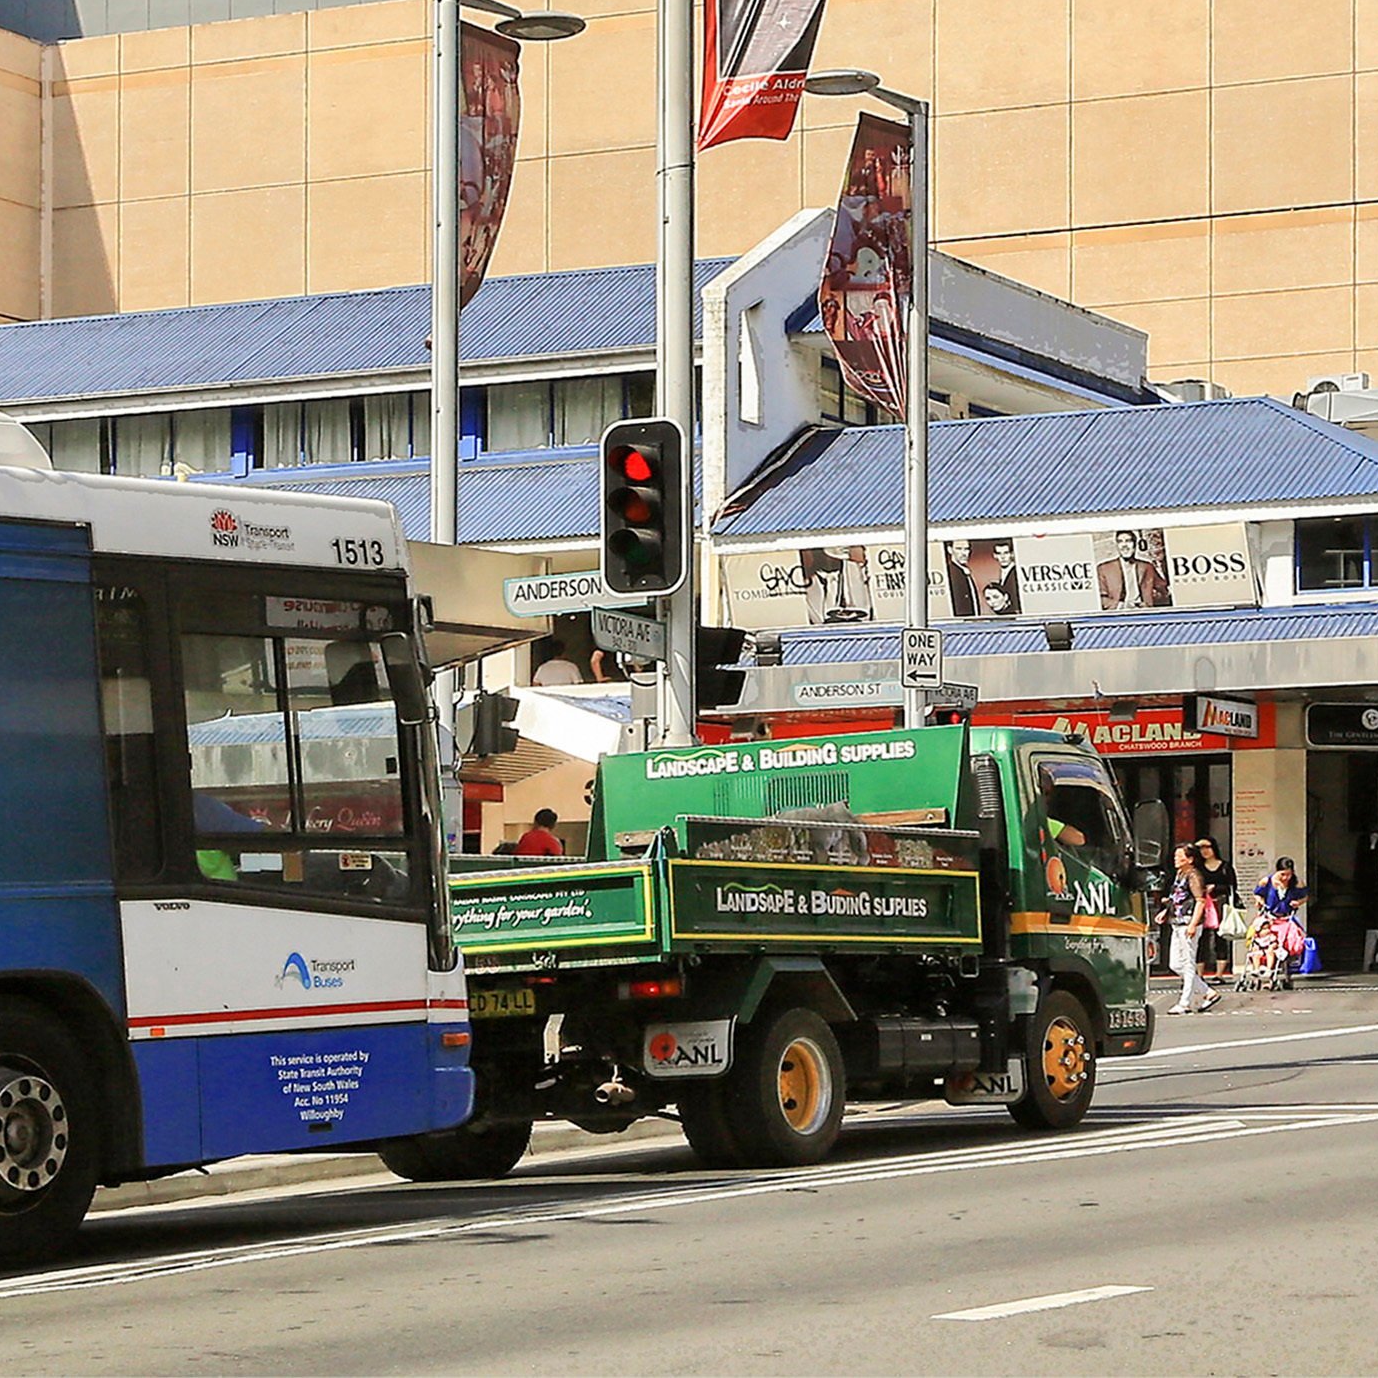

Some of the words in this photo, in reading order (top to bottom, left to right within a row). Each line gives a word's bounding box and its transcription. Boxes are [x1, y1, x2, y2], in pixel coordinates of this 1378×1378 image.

[244, 524, 290, 539] Transport
[213, 534, 239, 547] NSW
[332, 539, 384, 565] 1513
[1021, 562, 1093, 582] VERSACE
[1172, 553, 1246, 576] BOSS
[514, 577, 602, 602] ANDERSON
[1023, 583, 1069, 593] CLASSIC
[908, 635, 935, 649] ONE
[907, 653, 936, 666] WAY
[799, 684, 864, 699] ANDERSON
[868, 683, 882, 695] ST
[1119, 741, 1167, 751] CHATSWOOD
[1169, 740, 1203, 749] BRANCH
[646, 751, 739, 779] LANDSCAPE
[742, 755, 755, 771] &
[759, 743, 837, 769] BUILDING
[840, 740, 916, 763] SUPPLIES
[798, 894, 809, 914] &
[1073, 880, 1116, 915] ANL
[154, 902, 190, 911] VOLVO
[495, 906, 515, 927] for
[512, 908, 543, 927] your
[311, 959, 355, 973] Transport
[314, 976, 343, 988] Buses
[270, 1055, 286, 1066] This
[288, 1054, 314, 1065] service
[315, 1053, 322, 1063] is
[323, 1051, 358, 1064] operated
[359, 1050, 370, 1063] by
[675, 1043, 723, 1065] ANL
[278, 1070, 298, 1080] State
[299, 1068, 325, 1079] Transit
[327, 1066, 362, 1077] Authority
[283, 1083, 292, 1094] of
[293, 1083, 311, 1093] New
[312, 1081, 335, 1092] South
[336, 1079, 359, 1090] Wales
[971, 1075, 1018, 1093] ANL
[300, 1108, 344, 1121] Willoughby
